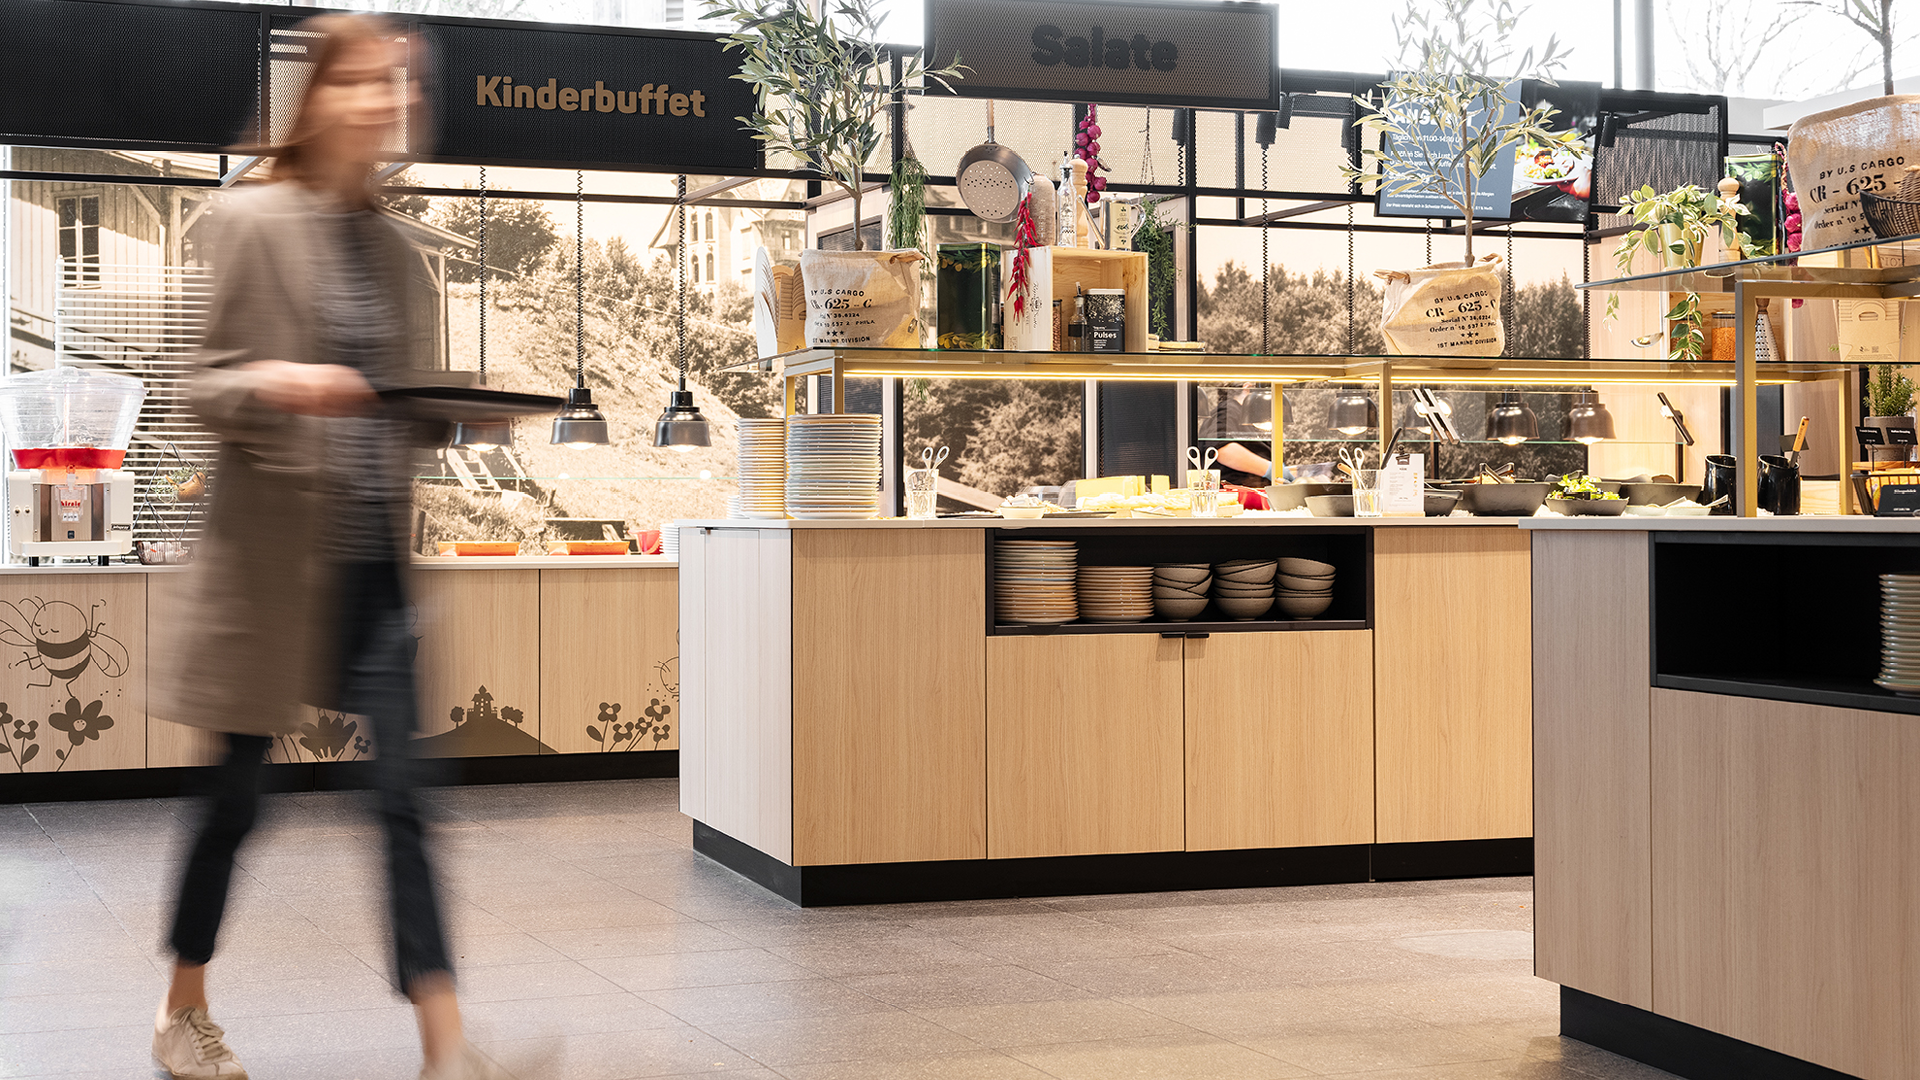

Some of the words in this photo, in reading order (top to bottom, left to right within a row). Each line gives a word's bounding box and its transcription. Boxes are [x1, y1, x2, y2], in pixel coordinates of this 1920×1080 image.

[1031, 24, 1179, 72] Salate
[476, 74, 706, 118] Kinderbuffet
[1820, 170, 1833, 180] BY
[1837, 164, 1855, 175] U.S
[1861, 156, 1905, 171] CARGO
[1809, 185, 1827, 204] CR
[1846, 173, 1887, 195] 625
[1823, 201, 1848, 214] Serial
[1847, 215, 1856, 224] 10
[836, 289, 864, 297] CARGO
[824, 298, 850, 310] 625
[863, 299, 873, 310] C
[1425, 307, 1445, 318] CR
[1458, 300, 1483, 314] 625
[841, 336, 871, 344] DIVISION
